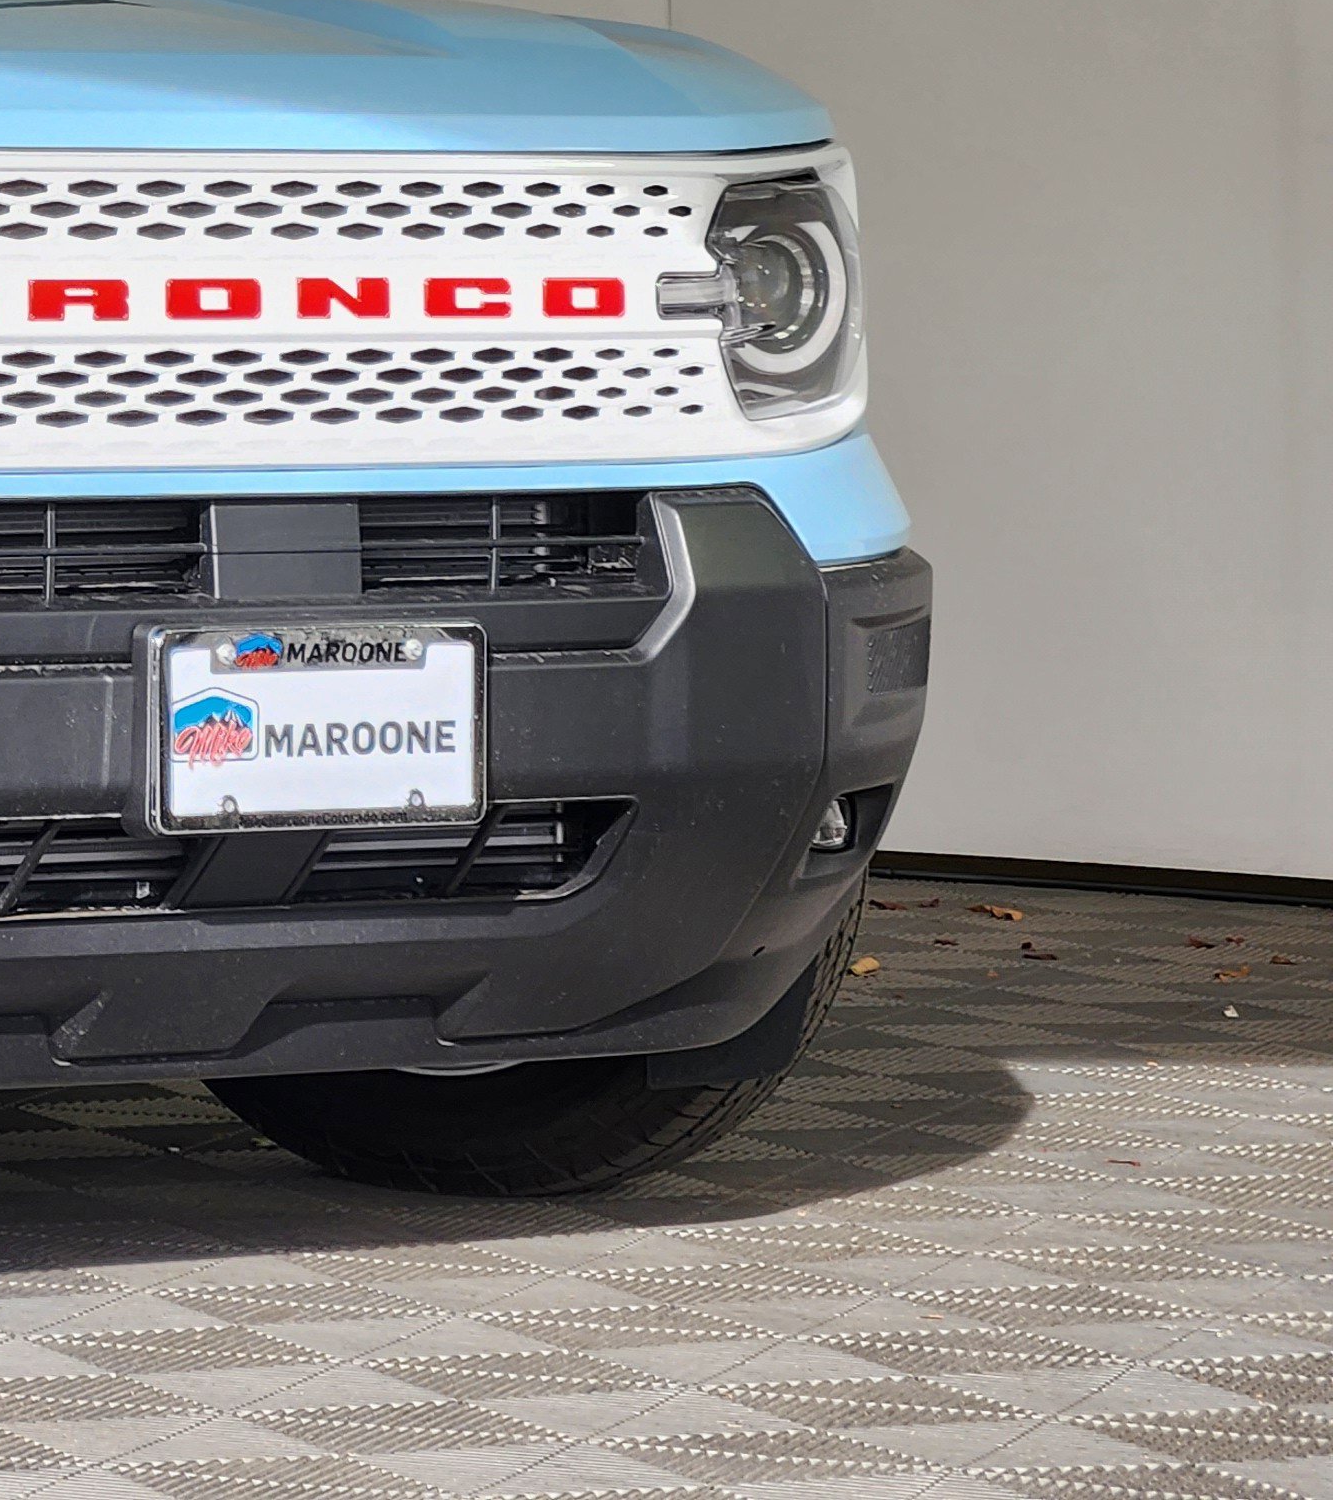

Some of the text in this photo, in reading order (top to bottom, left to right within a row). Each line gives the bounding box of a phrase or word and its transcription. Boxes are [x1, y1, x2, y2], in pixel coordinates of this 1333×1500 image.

[286, 642, 407, 664] MAROONE
[174, 720, 457, 769] Mike MAROONE
